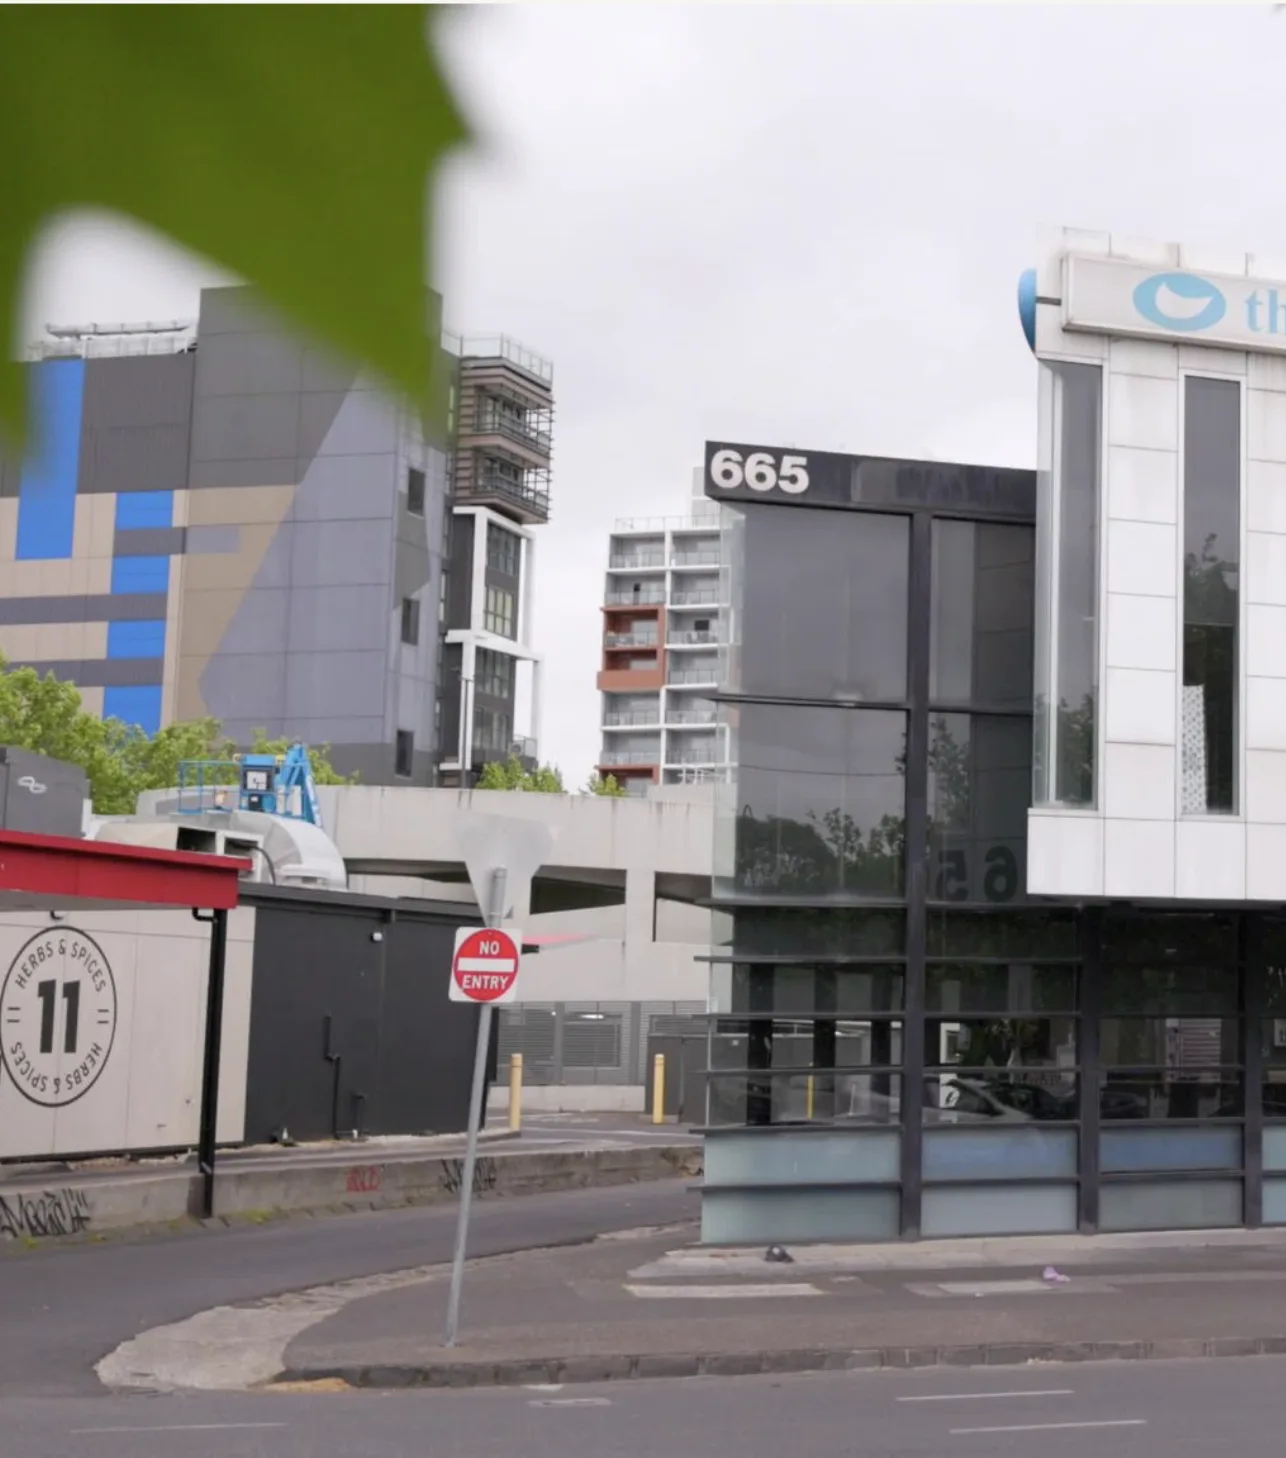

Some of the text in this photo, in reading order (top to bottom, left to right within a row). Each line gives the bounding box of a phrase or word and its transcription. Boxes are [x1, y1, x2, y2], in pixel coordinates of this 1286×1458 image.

[710, 450, 810, 493] 665
[15, 938, 106, 992] HERBS & SPICES
[479, 940, 500, 955] NO
[462, 974, 509, 990] ENTRY
[37, 978, 81, 1054] 11
[10, 1041, 103, 1094] HERBS & SPICES
